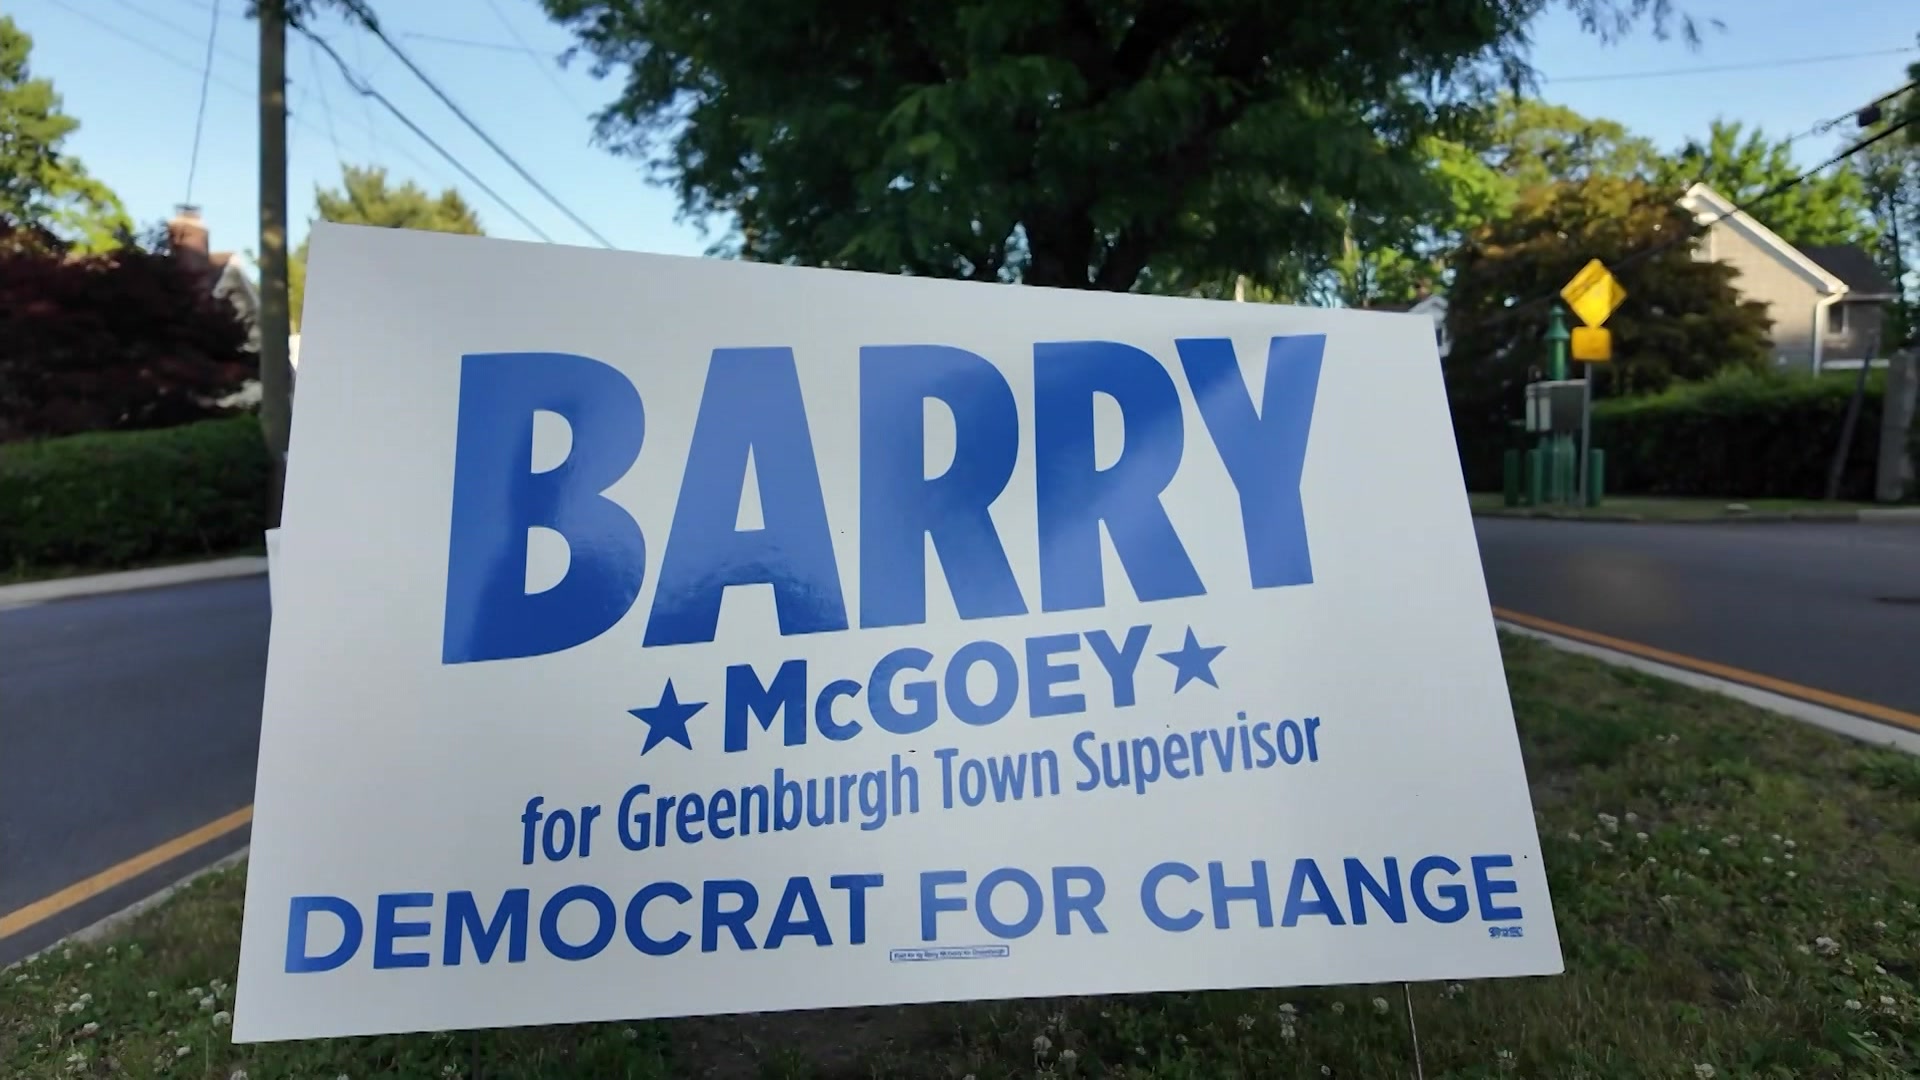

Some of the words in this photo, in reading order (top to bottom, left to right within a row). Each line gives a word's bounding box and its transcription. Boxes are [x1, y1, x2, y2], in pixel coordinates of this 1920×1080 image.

[441, 332, 1327, 665] BARRY
[723, 624, 1152, 753] McGOEY
[521, 796, 601, 864] for
[617, 752, 919, 851] Greenburgh
[934, 747, 1060, 809] Town
[1072, 711, 1321, 795] Supervisor
[284, 873, 884, 974] DEMOCRAT
[919, 865, 1108, 942] FOR
[1140, 854, 1523, 933] CHANGE
